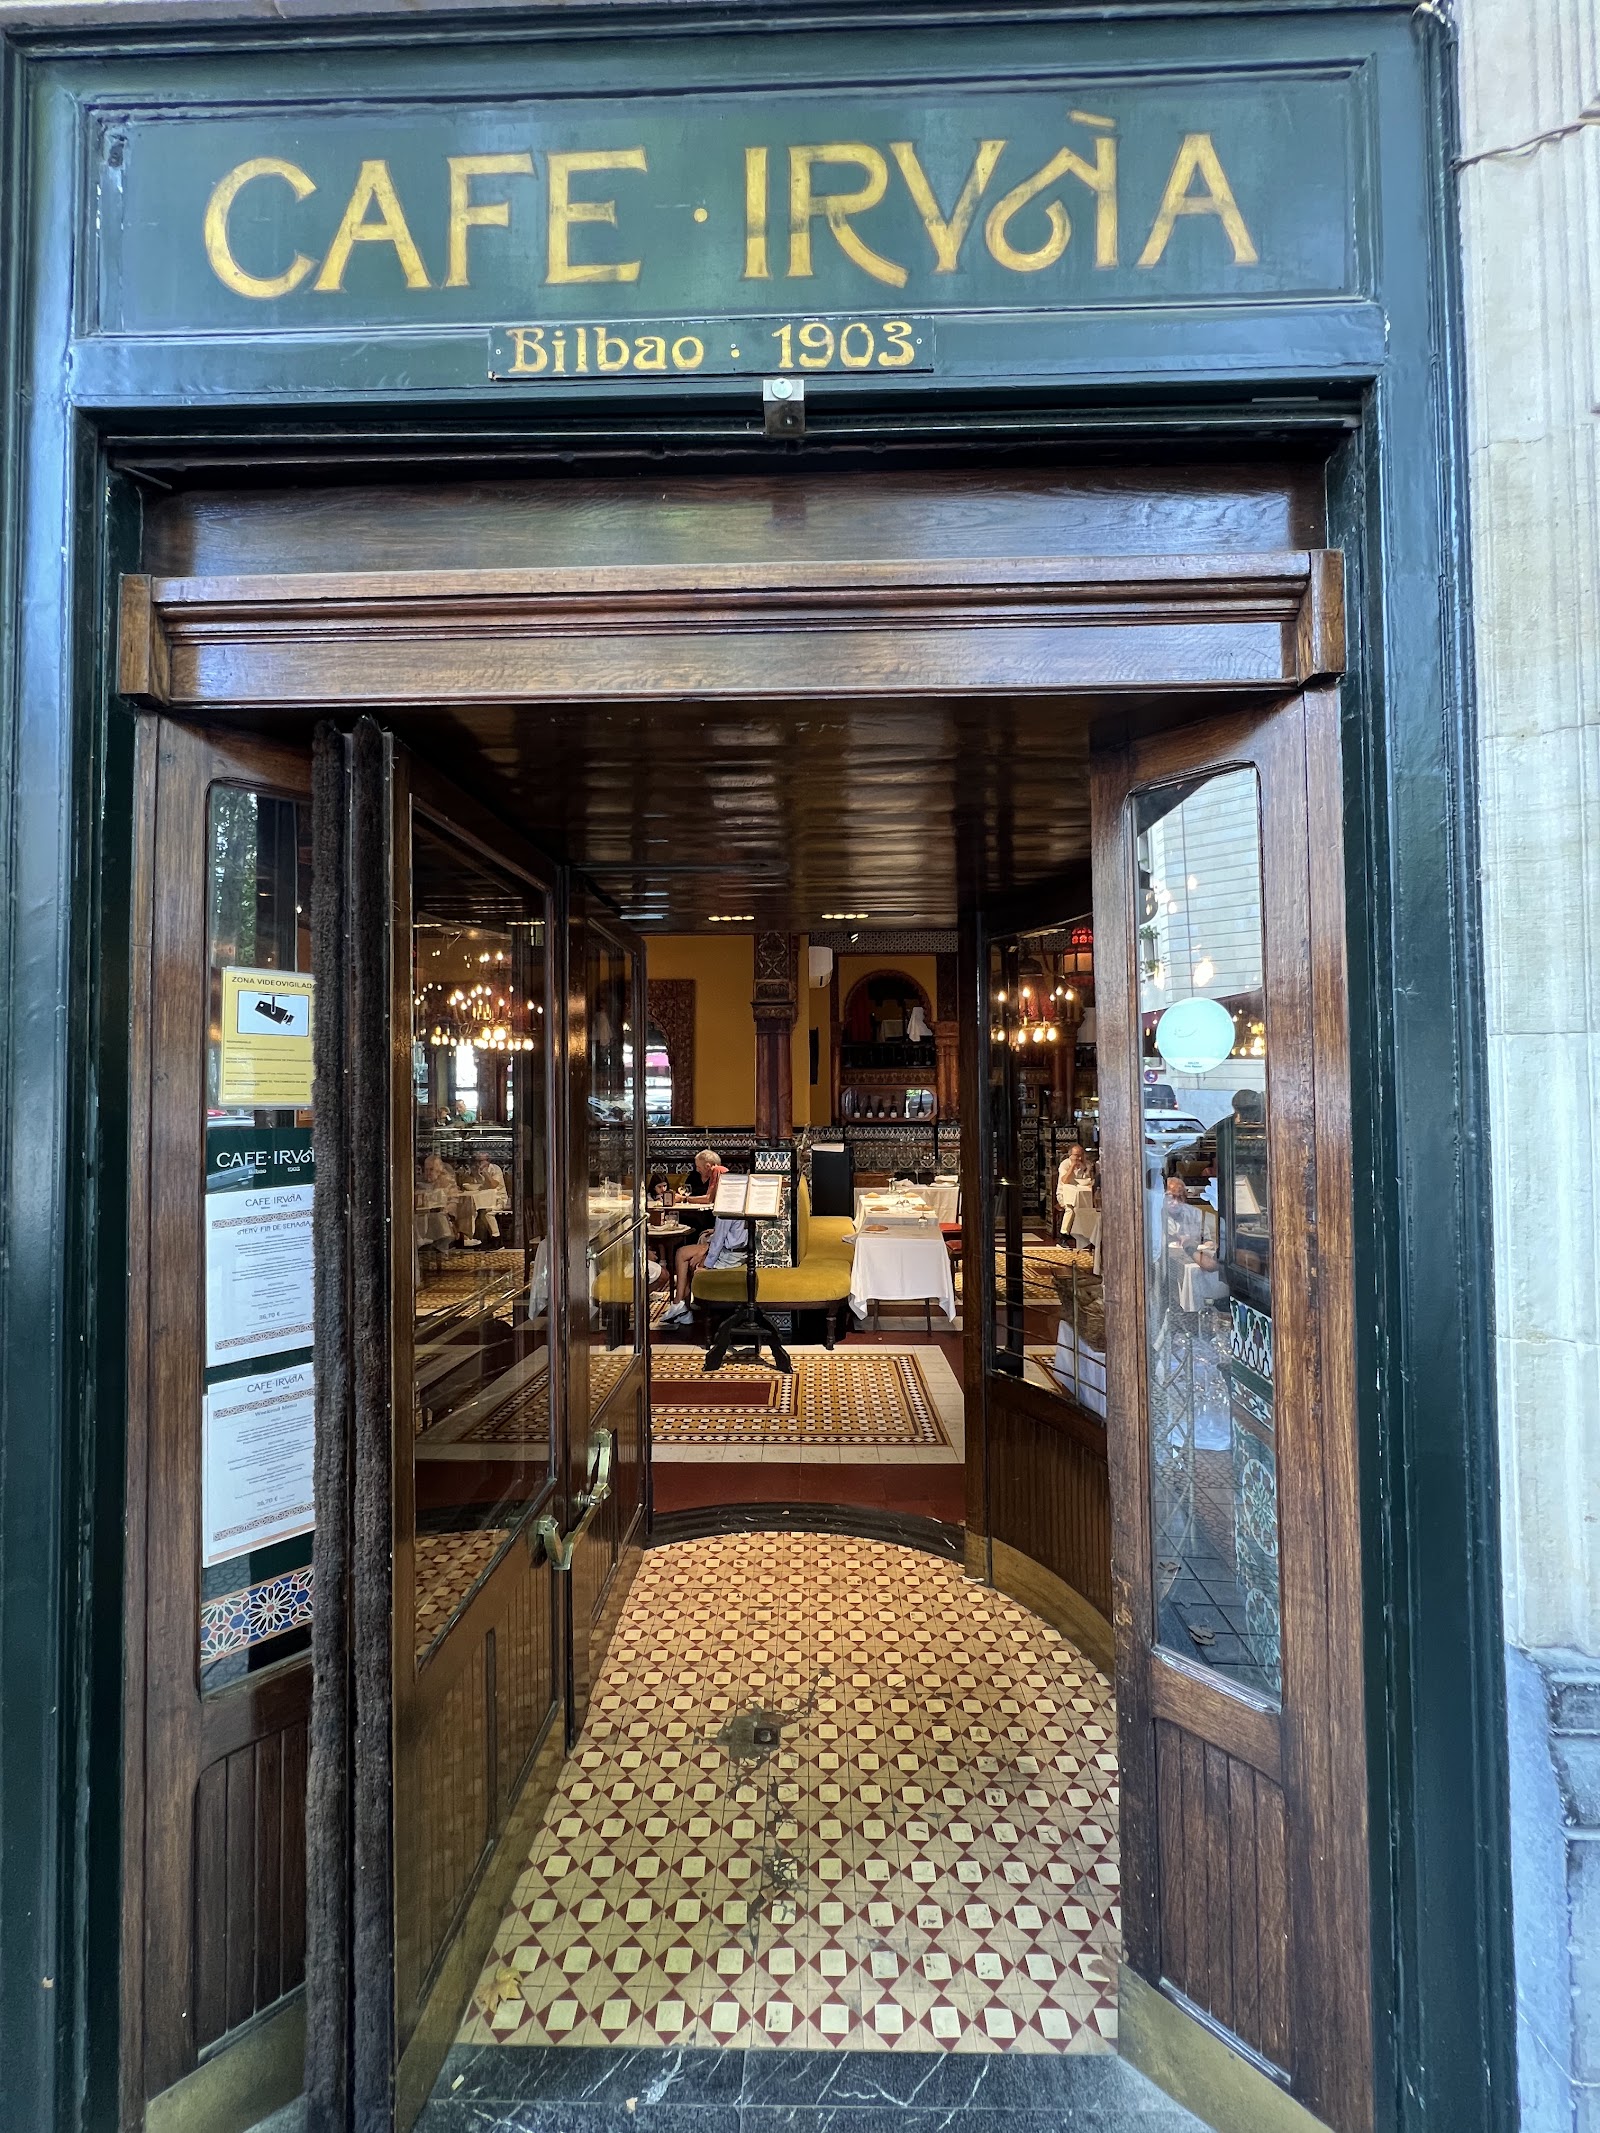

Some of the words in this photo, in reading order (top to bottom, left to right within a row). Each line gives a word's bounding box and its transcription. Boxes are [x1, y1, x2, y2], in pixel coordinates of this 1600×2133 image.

[203, 147, 647, 300] CAFE
[511, 327, 706, 374] Bilbao
[771, 320, 917, 369] 1903
[232, 976, 255, 984] ZONA
[257, 979, 316, 989] VIDEOVIGILAD
[216, 1151, 267, 1168] CAFE
[273, 1147, 315, 1165] IRVÑ
[245, 1197, 271, 1207] CAFE
[247, 1380, 272, 1393] CAFE
